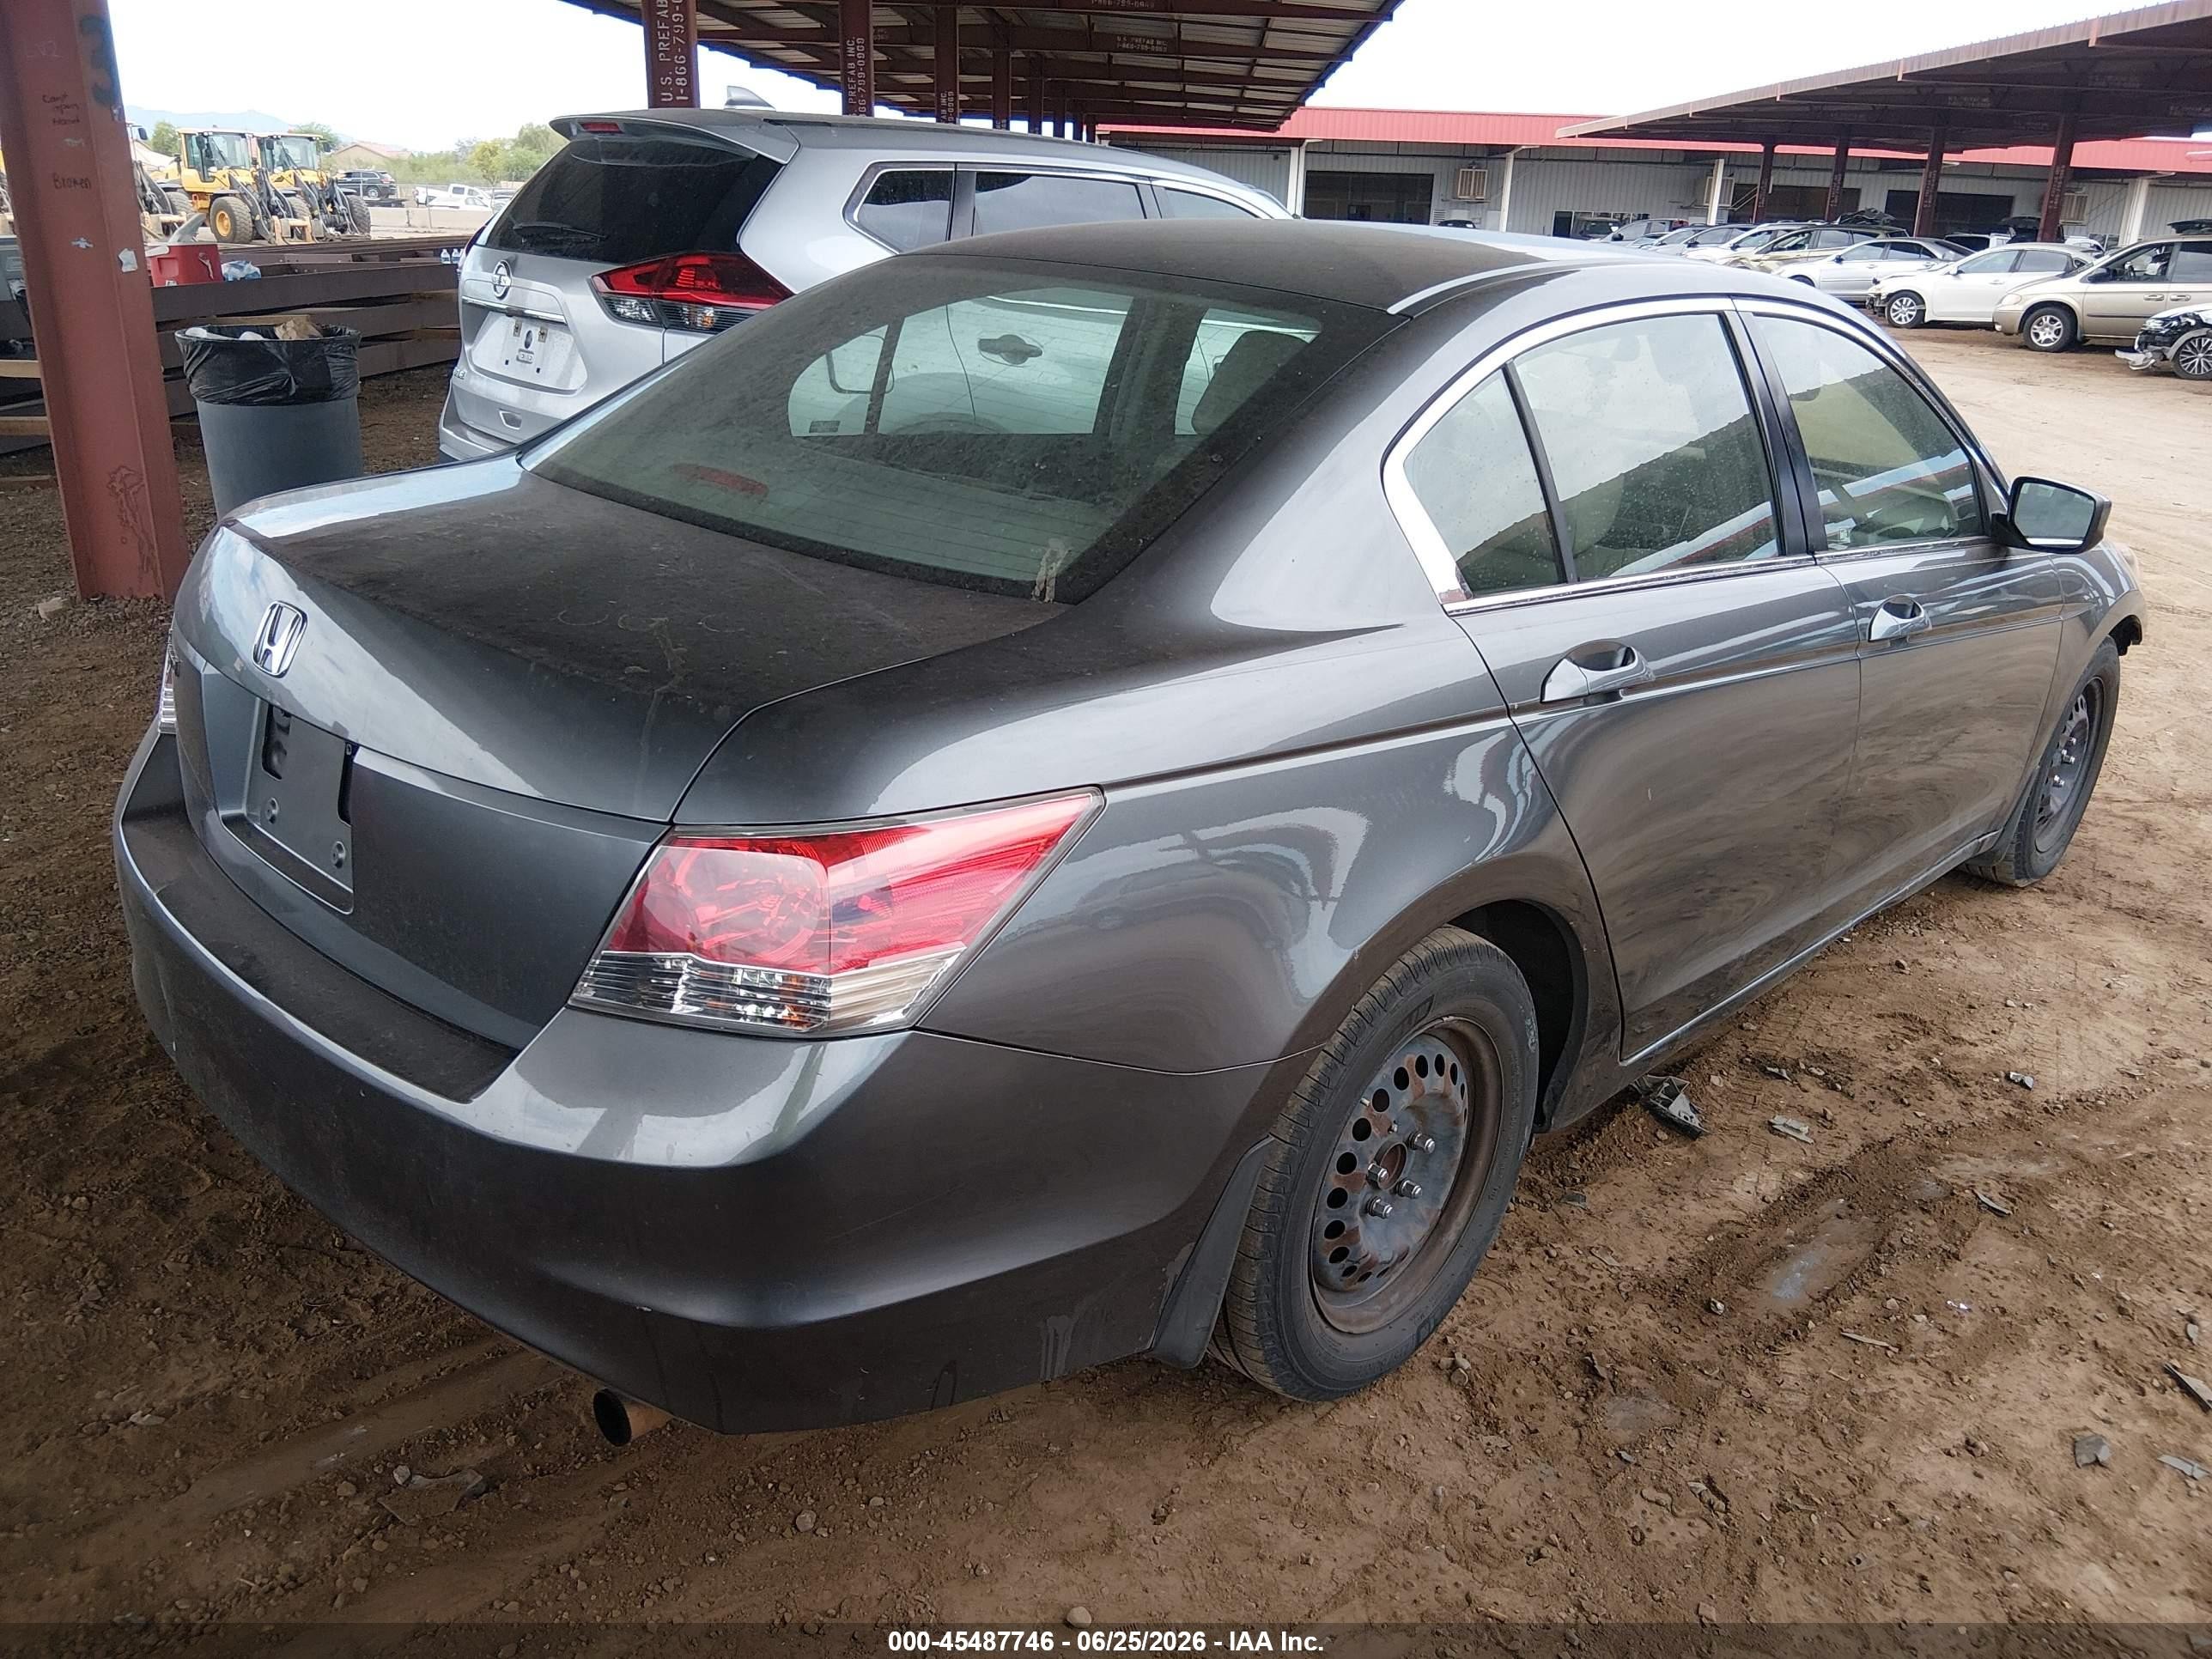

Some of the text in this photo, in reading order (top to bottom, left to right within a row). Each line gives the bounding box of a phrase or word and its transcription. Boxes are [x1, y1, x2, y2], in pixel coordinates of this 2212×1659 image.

[655, 0, 673, 102] U.S. PREFAB
[846, 36, 856, 58] INC.
[847, 62, 857, 104] PREFAB
